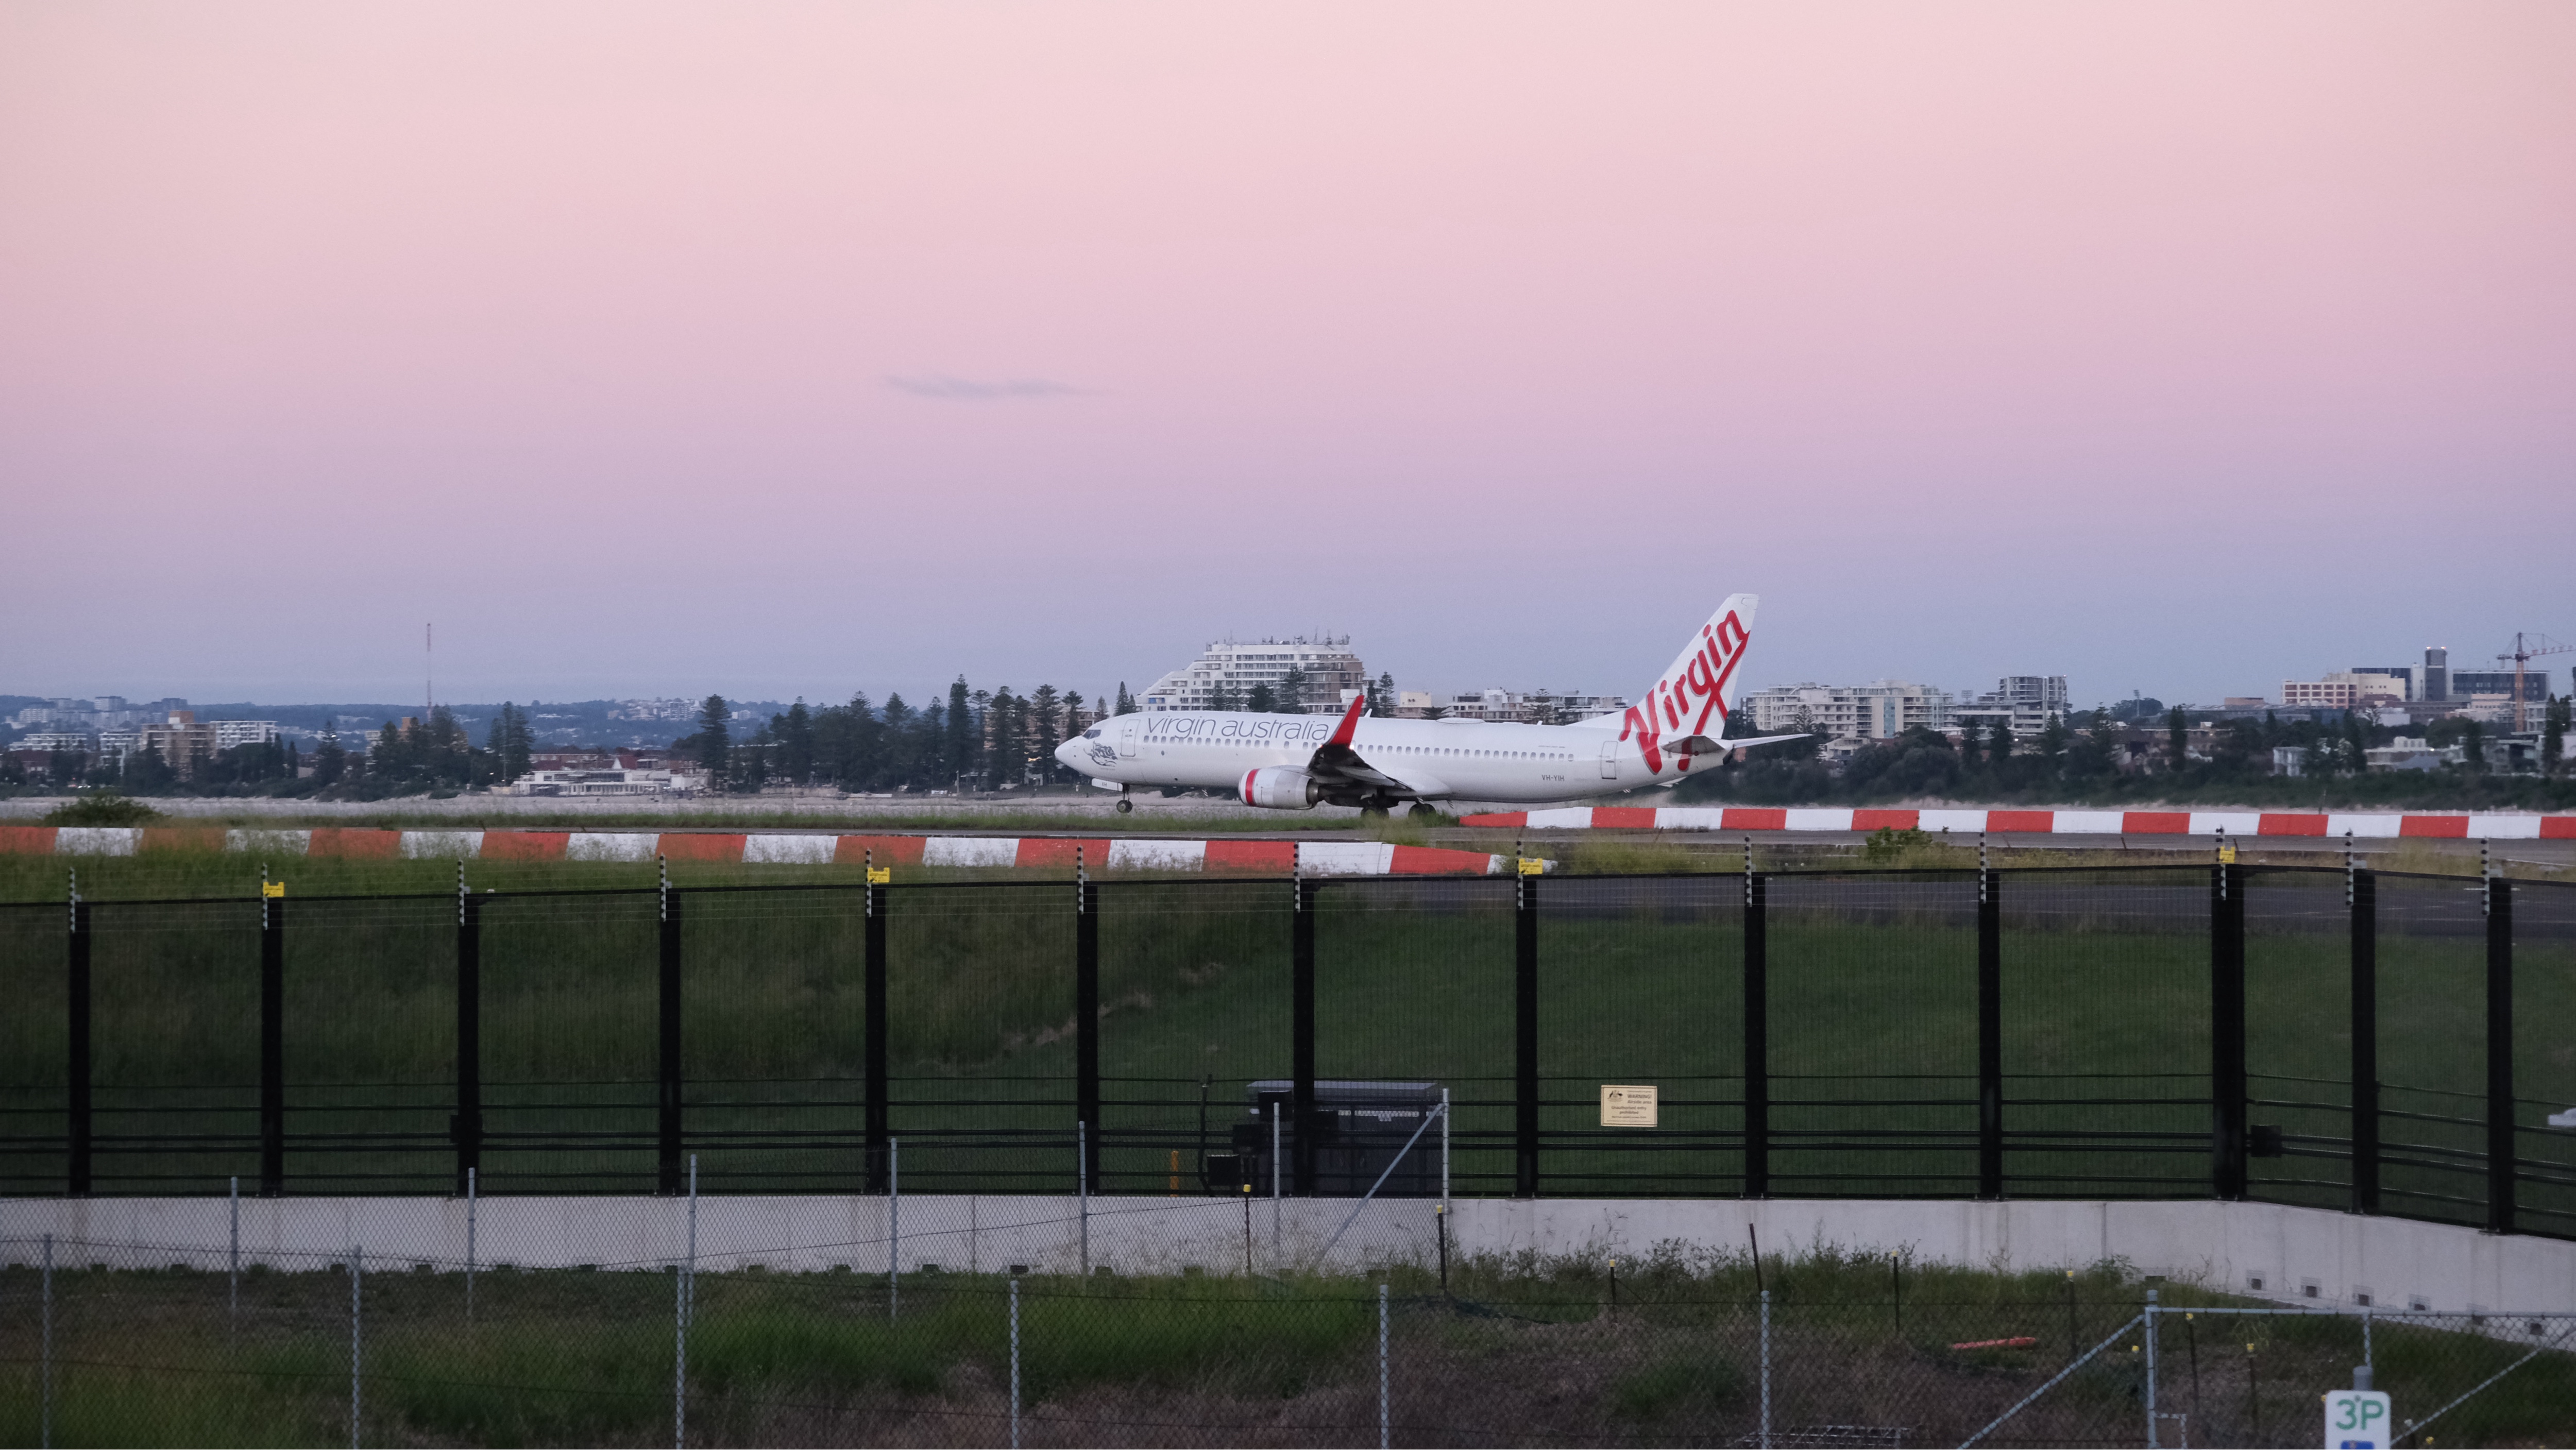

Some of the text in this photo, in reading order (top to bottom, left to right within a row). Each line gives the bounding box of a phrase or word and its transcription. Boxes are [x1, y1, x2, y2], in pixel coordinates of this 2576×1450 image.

[1619, 609, 1751, 775] Virgin
[1148, 716, 1329, 740] virgin australia
[2335, 1399, 2384, 1430] 3P
